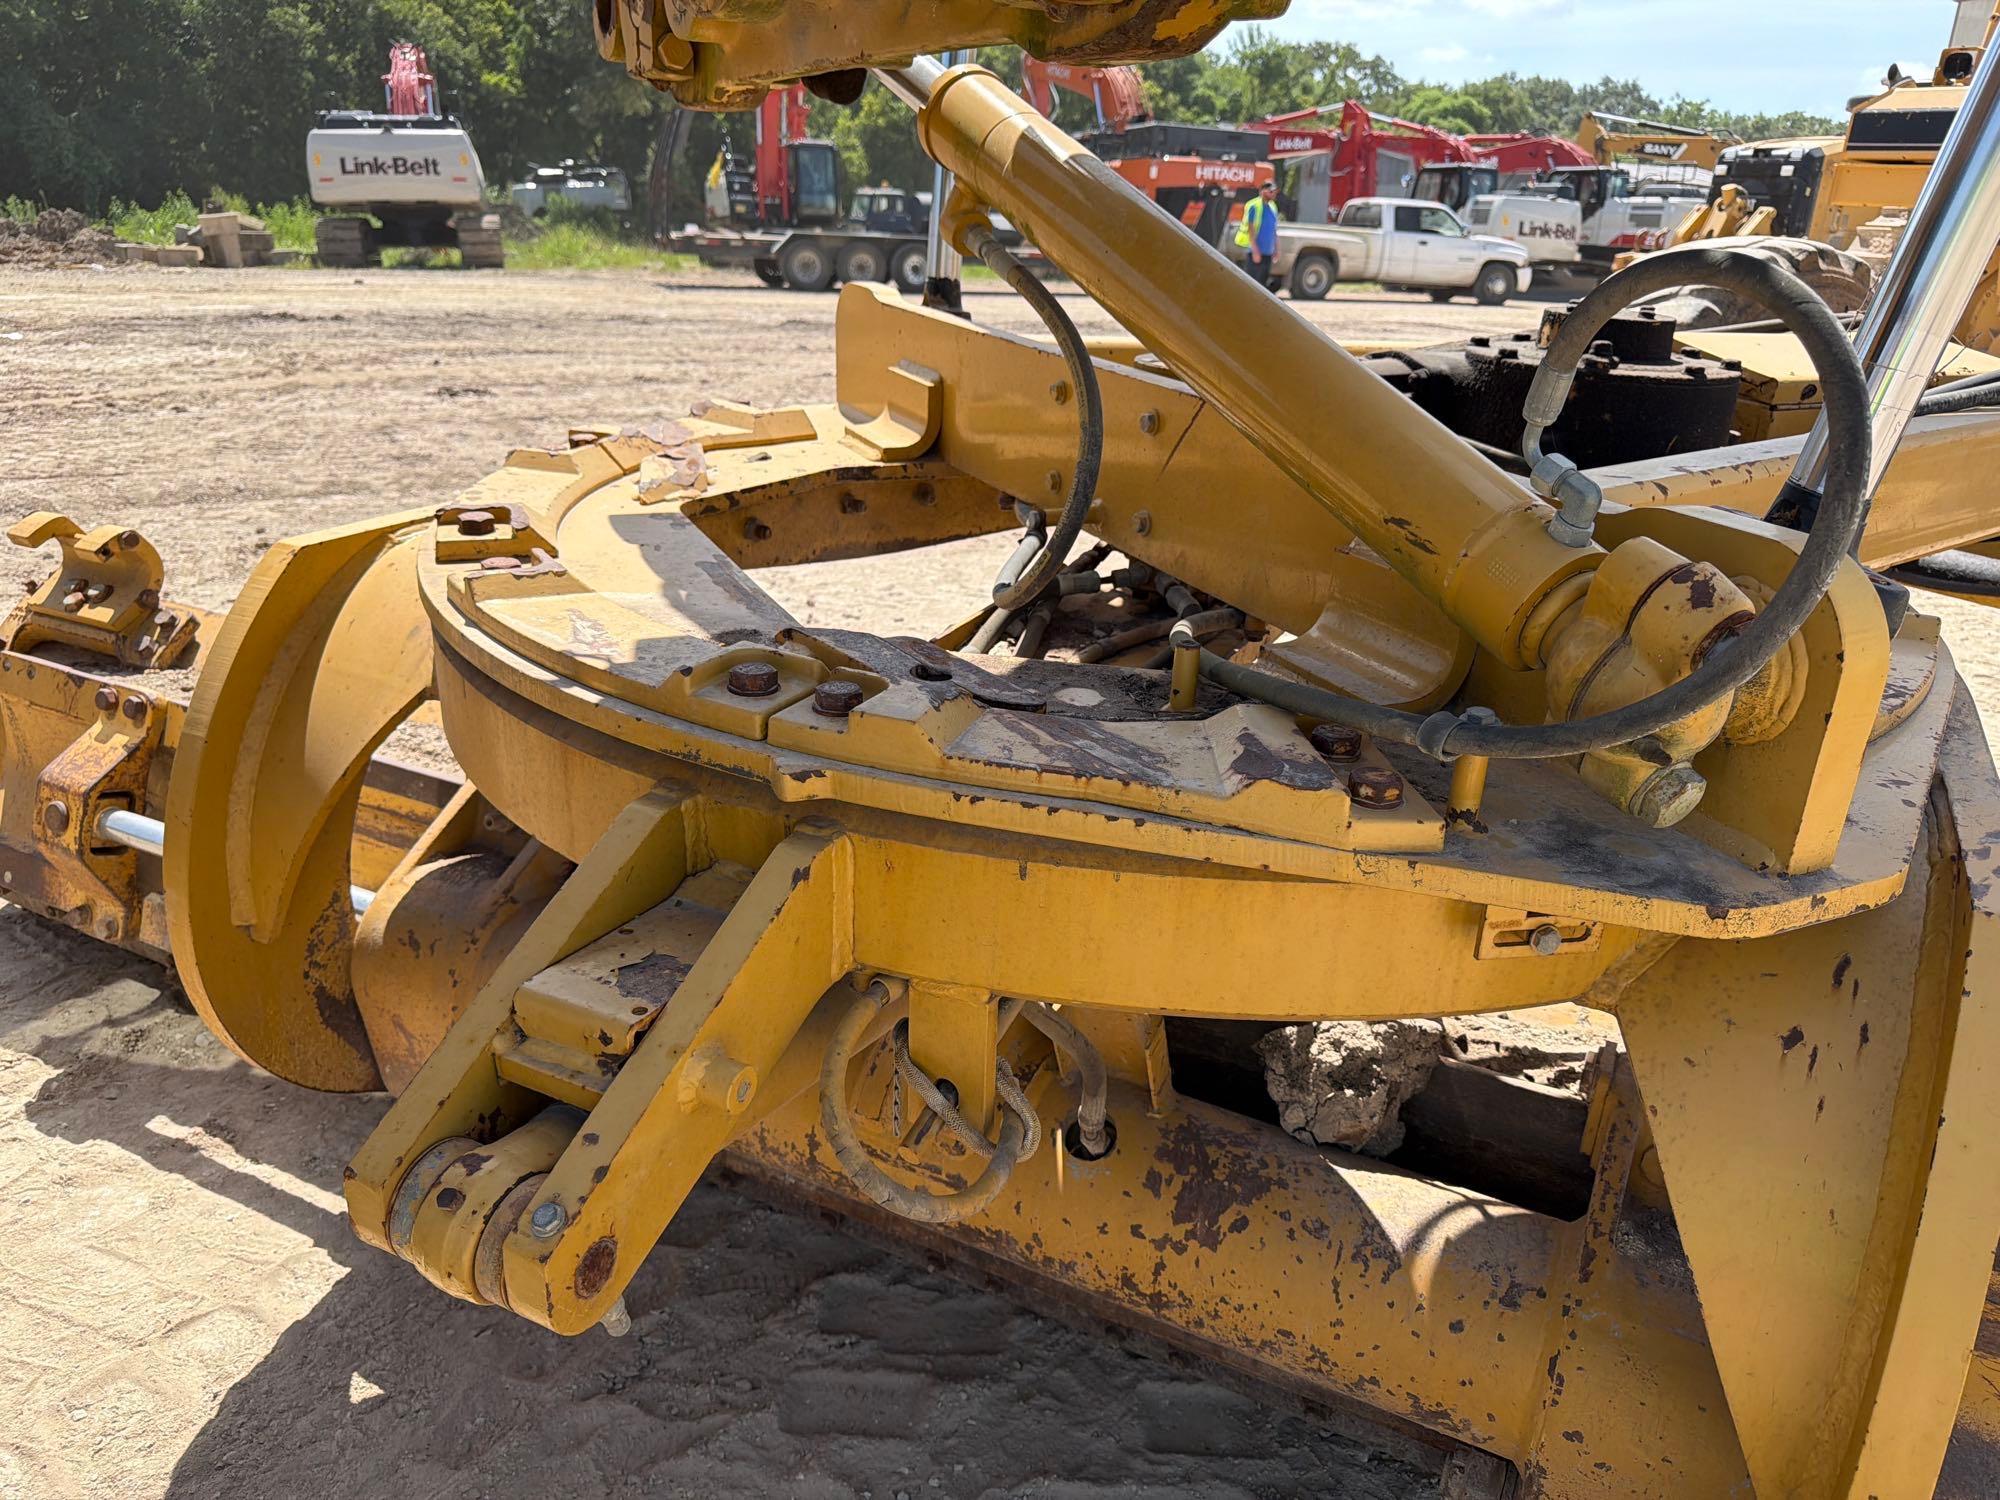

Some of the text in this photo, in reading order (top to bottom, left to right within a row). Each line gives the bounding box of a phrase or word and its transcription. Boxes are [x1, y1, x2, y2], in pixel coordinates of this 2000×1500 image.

[1643, 143, 1678, 156] SANY
[340, 156, 440, 176] Link-Belt
[1195, 164, 1255, 183] HITACHI
